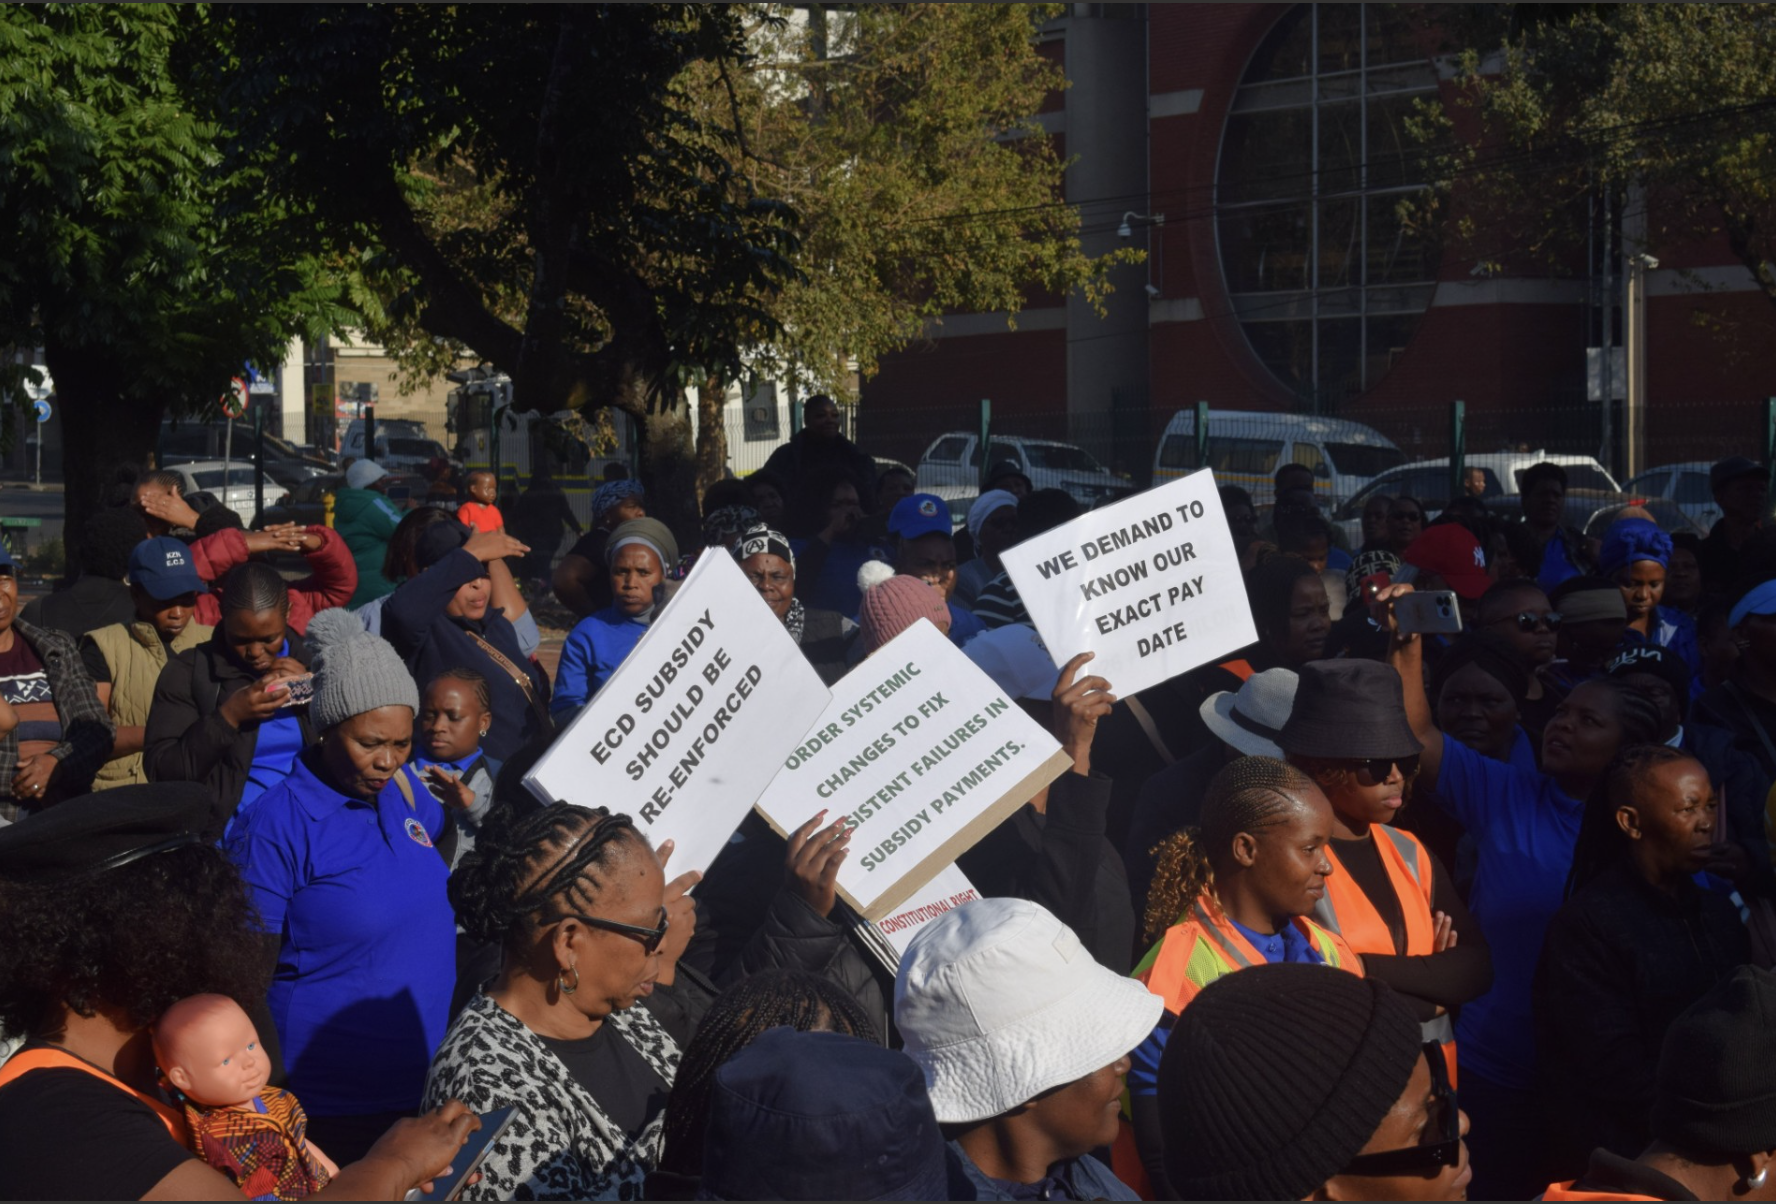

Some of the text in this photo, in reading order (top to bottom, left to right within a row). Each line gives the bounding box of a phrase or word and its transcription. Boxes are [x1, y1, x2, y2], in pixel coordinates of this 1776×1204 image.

[1035, 500, 1205, 580] WE DEMAND TO
[1079, 542, 1197, 602] KNOW OUR
[1094, 593, 1162, 636] EXACT
[1167, 576, 1204, 607] PAY
[1137, 622, 1188, 658] DATE
[589, 608, 715, 766] ECD SUBSIDY
[625, 647, 732, 782] SHOULD BE
[784, 661, 922, 771] ORDER SYSTEMIC
[638, 664, 763, 826] RE-ENFORCED
[816, 691, 951, 799] CHANGES TO FIX
[829, 697, 1010, 843] SISTENT FAILURES IN
[859, 740, 1027, 872] SUBSIDY PAYMENTS.
[879, 888, 979, 935] CONSTITUTIONAL RIGHT
